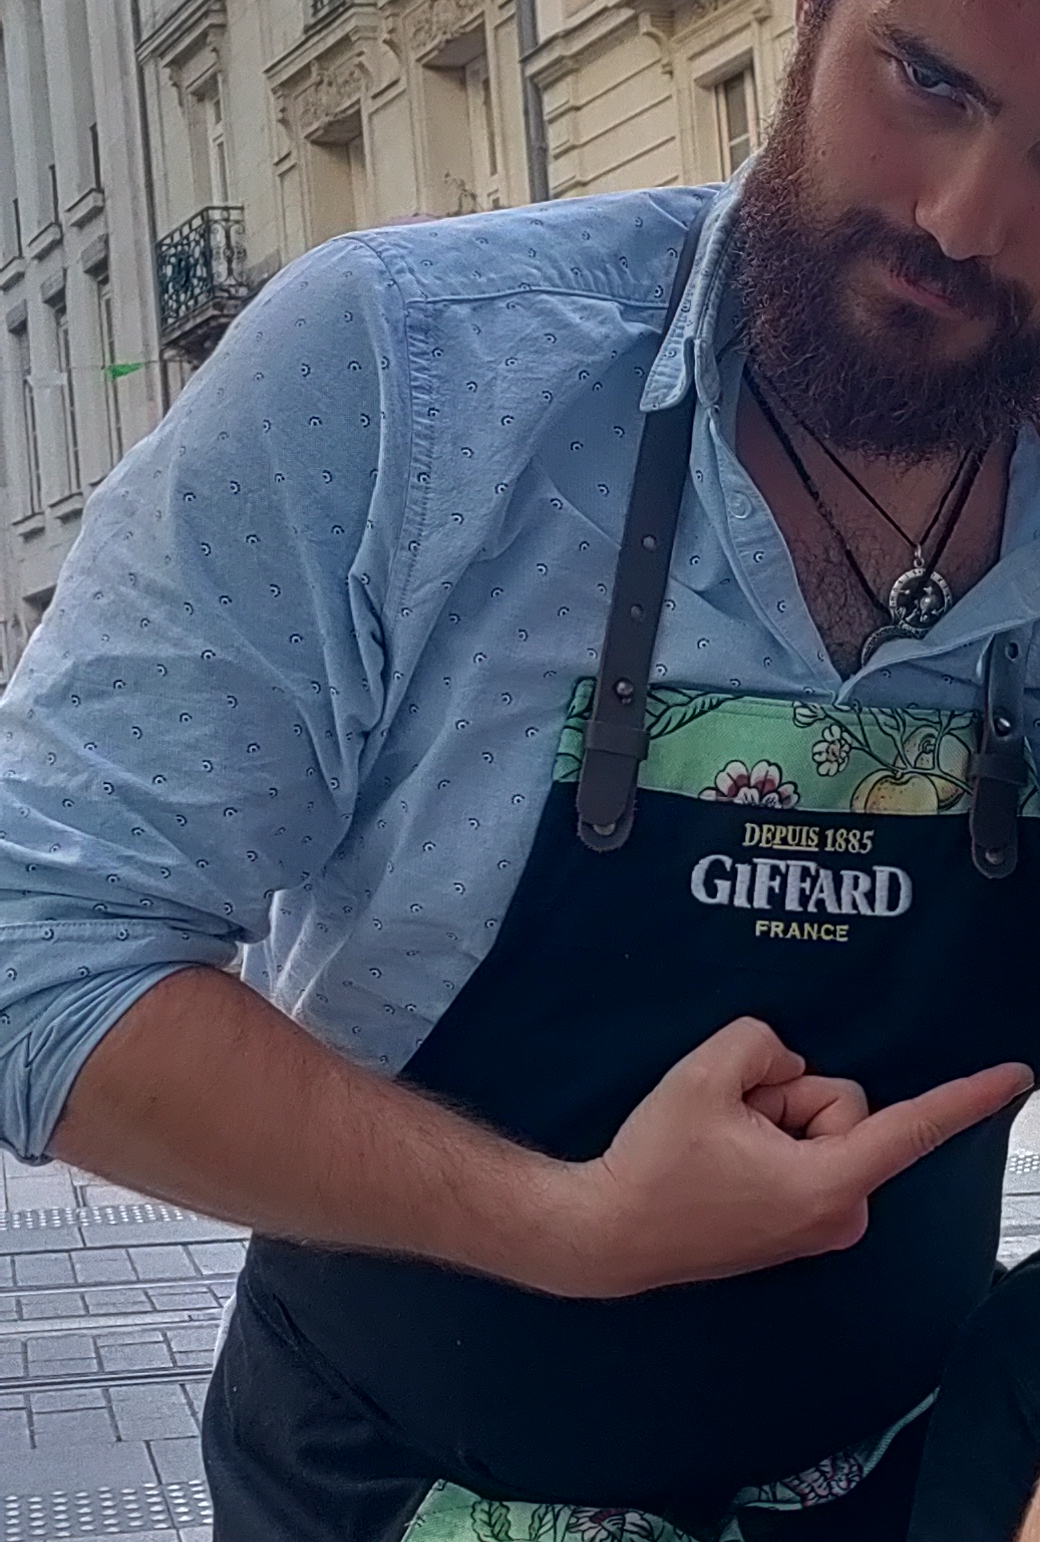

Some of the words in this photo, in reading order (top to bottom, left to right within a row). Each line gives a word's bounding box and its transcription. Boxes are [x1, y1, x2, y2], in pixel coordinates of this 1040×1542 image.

[742, 822, 820, 852] DEPUIS
[823, 828, 875, 854] 1885
[690, 854, 913, 917] GIFFARD
[754, 920, 850, 942] FRANCE
